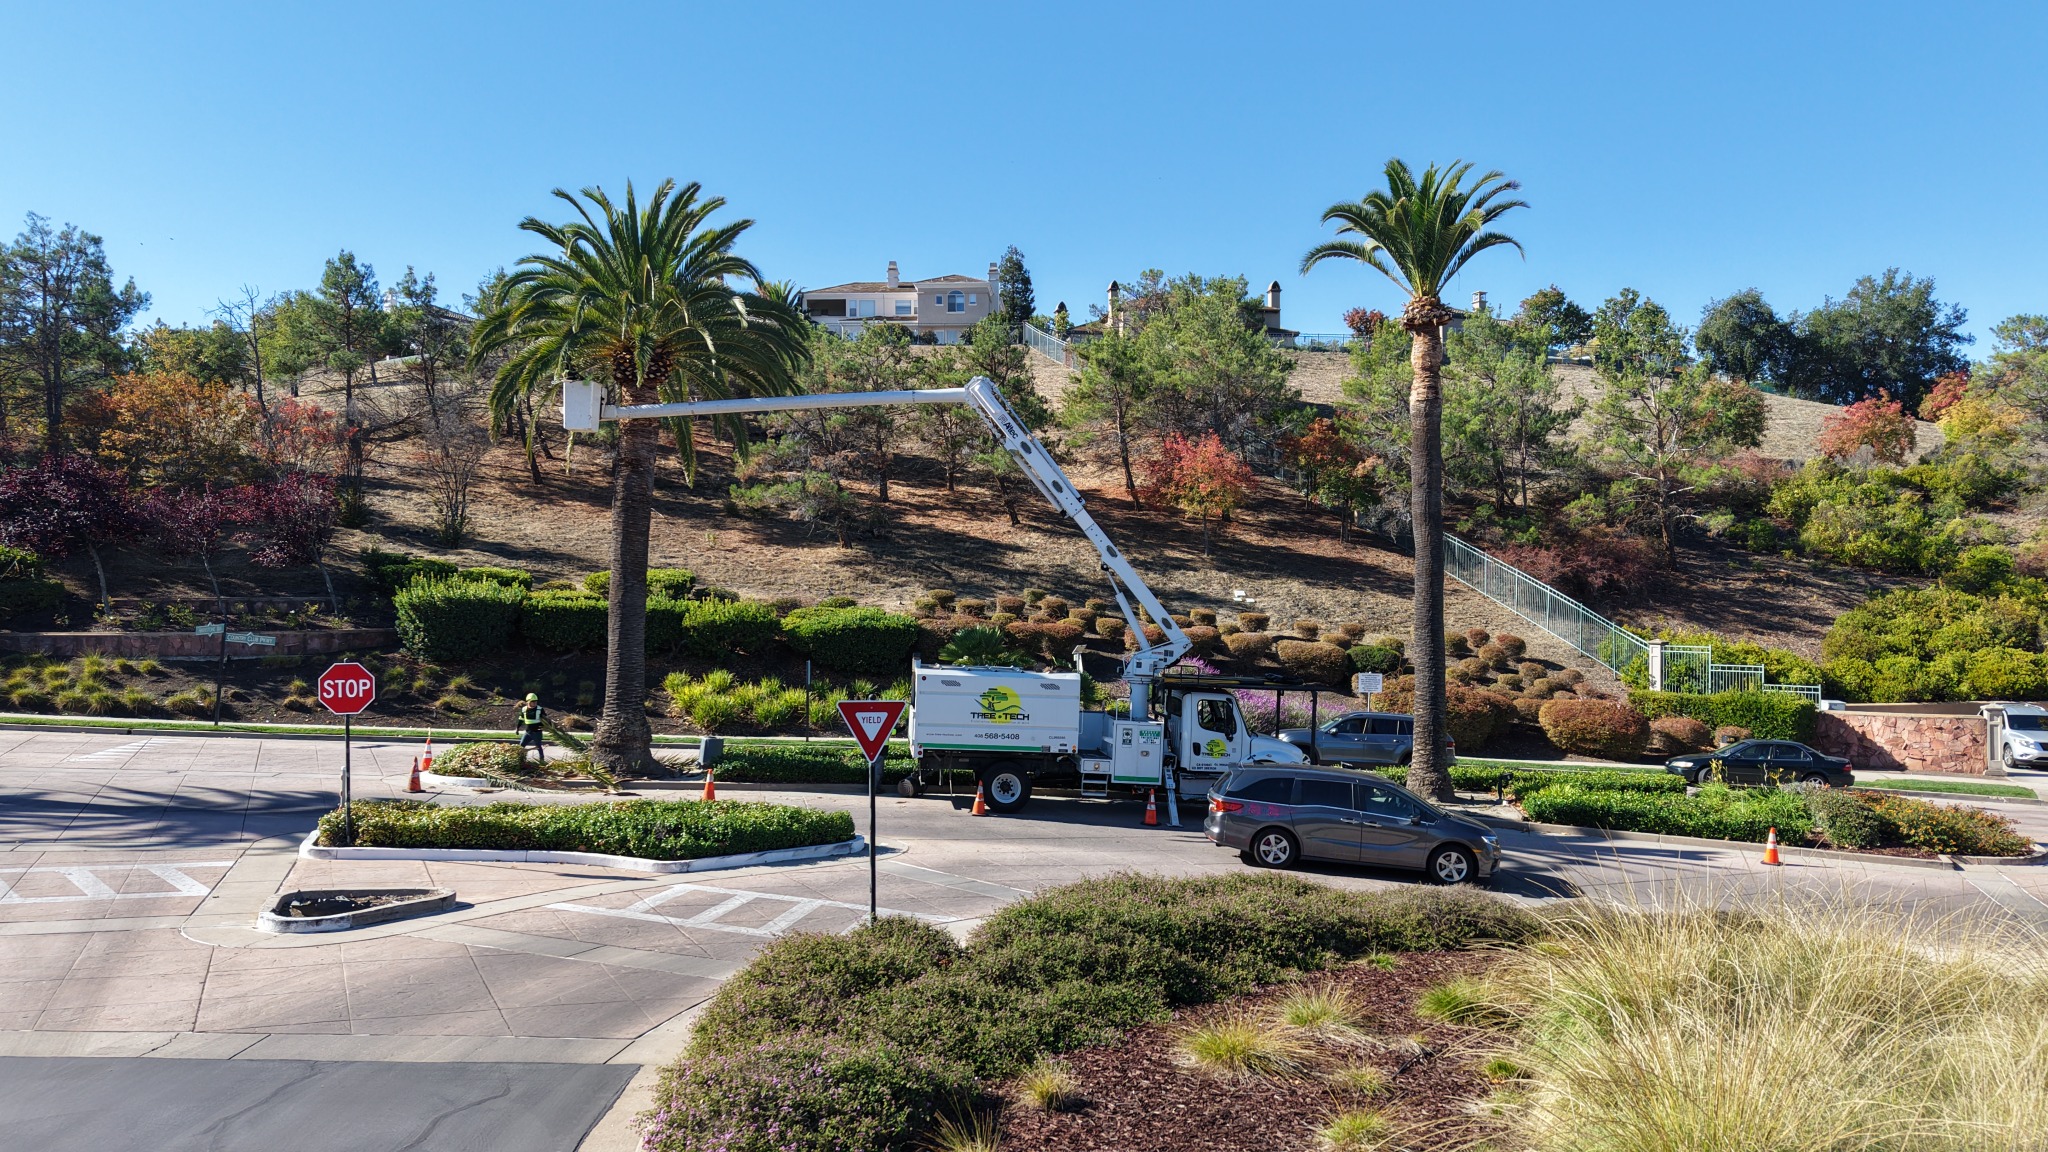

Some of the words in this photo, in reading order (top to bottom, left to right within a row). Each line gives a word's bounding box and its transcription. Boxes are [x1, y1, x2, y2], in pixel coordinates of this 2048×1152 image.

[1003, 422, 1018, 439] Altec
[323, 679, 371, 698] STOP
[861, 716, 882, 724] YIELD
[970, 712, 996, 720] TREE
[1002, 713, 1030, 721] TECH
